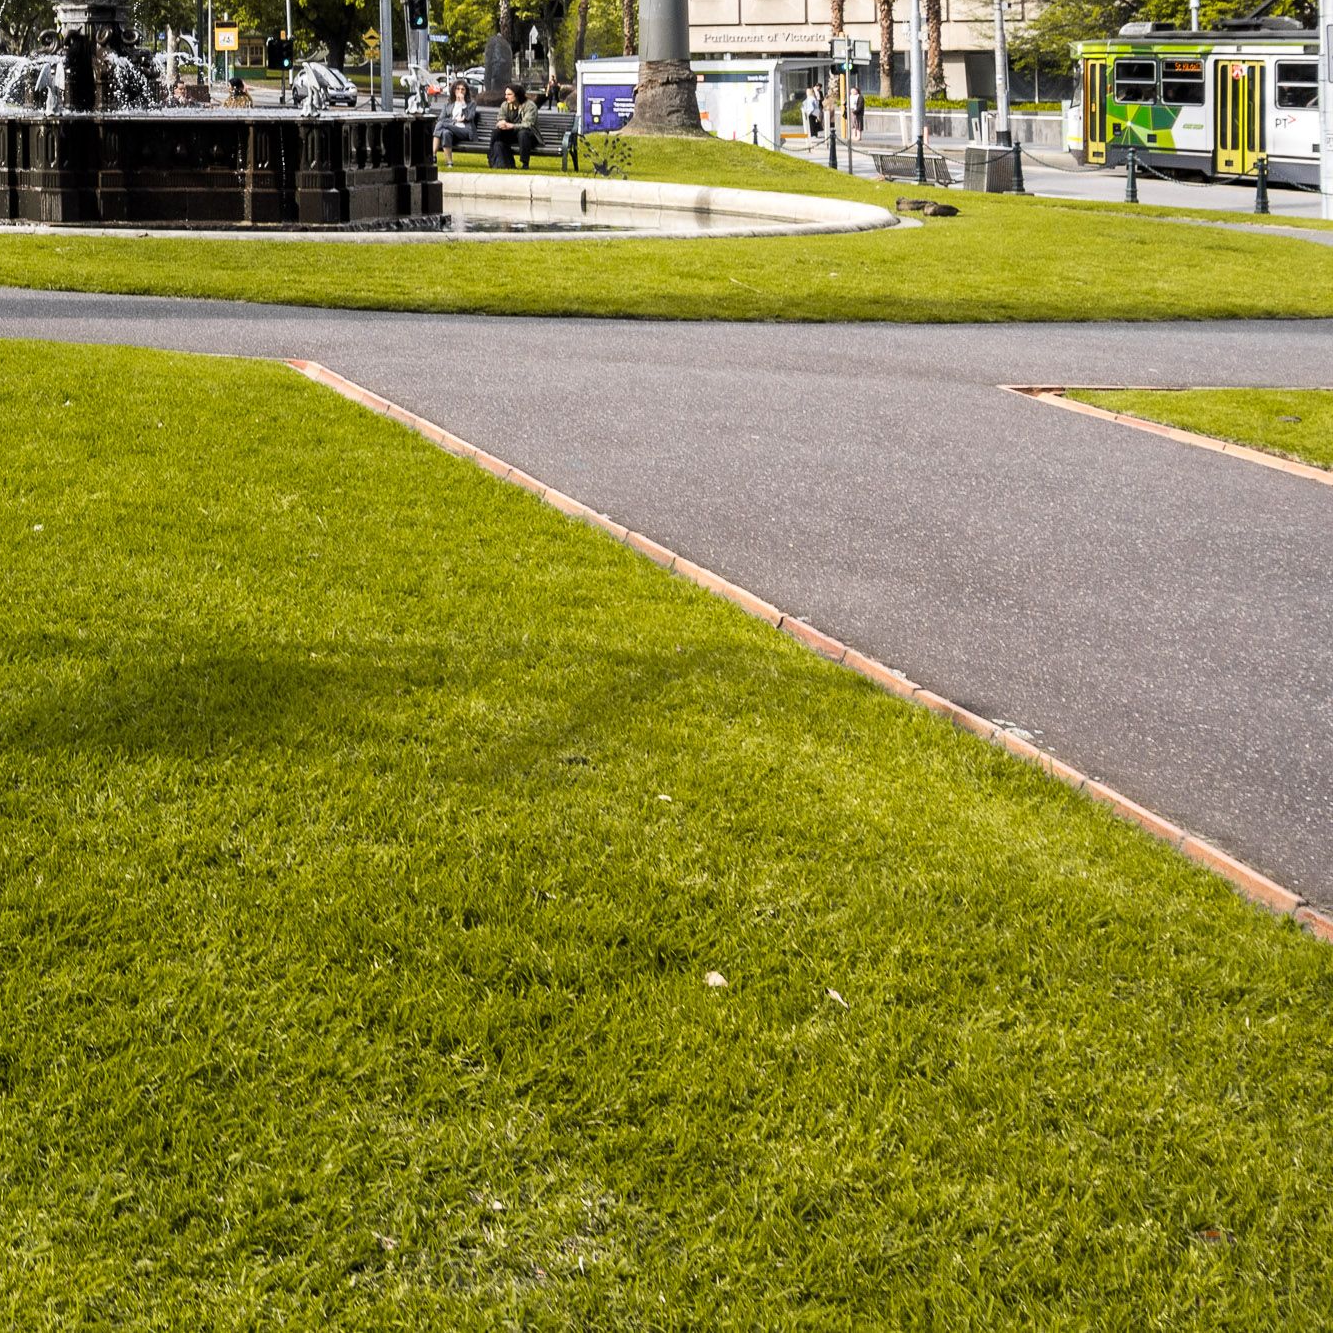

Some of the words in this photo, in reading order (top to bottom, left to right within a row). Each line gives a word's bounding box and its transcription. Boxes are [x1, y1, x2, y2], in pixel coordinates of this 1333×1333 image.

[703, 33, 764, 43] Parliament
[767, 32, 779, 43] of
[781, 32, 826, 42] Victoria
